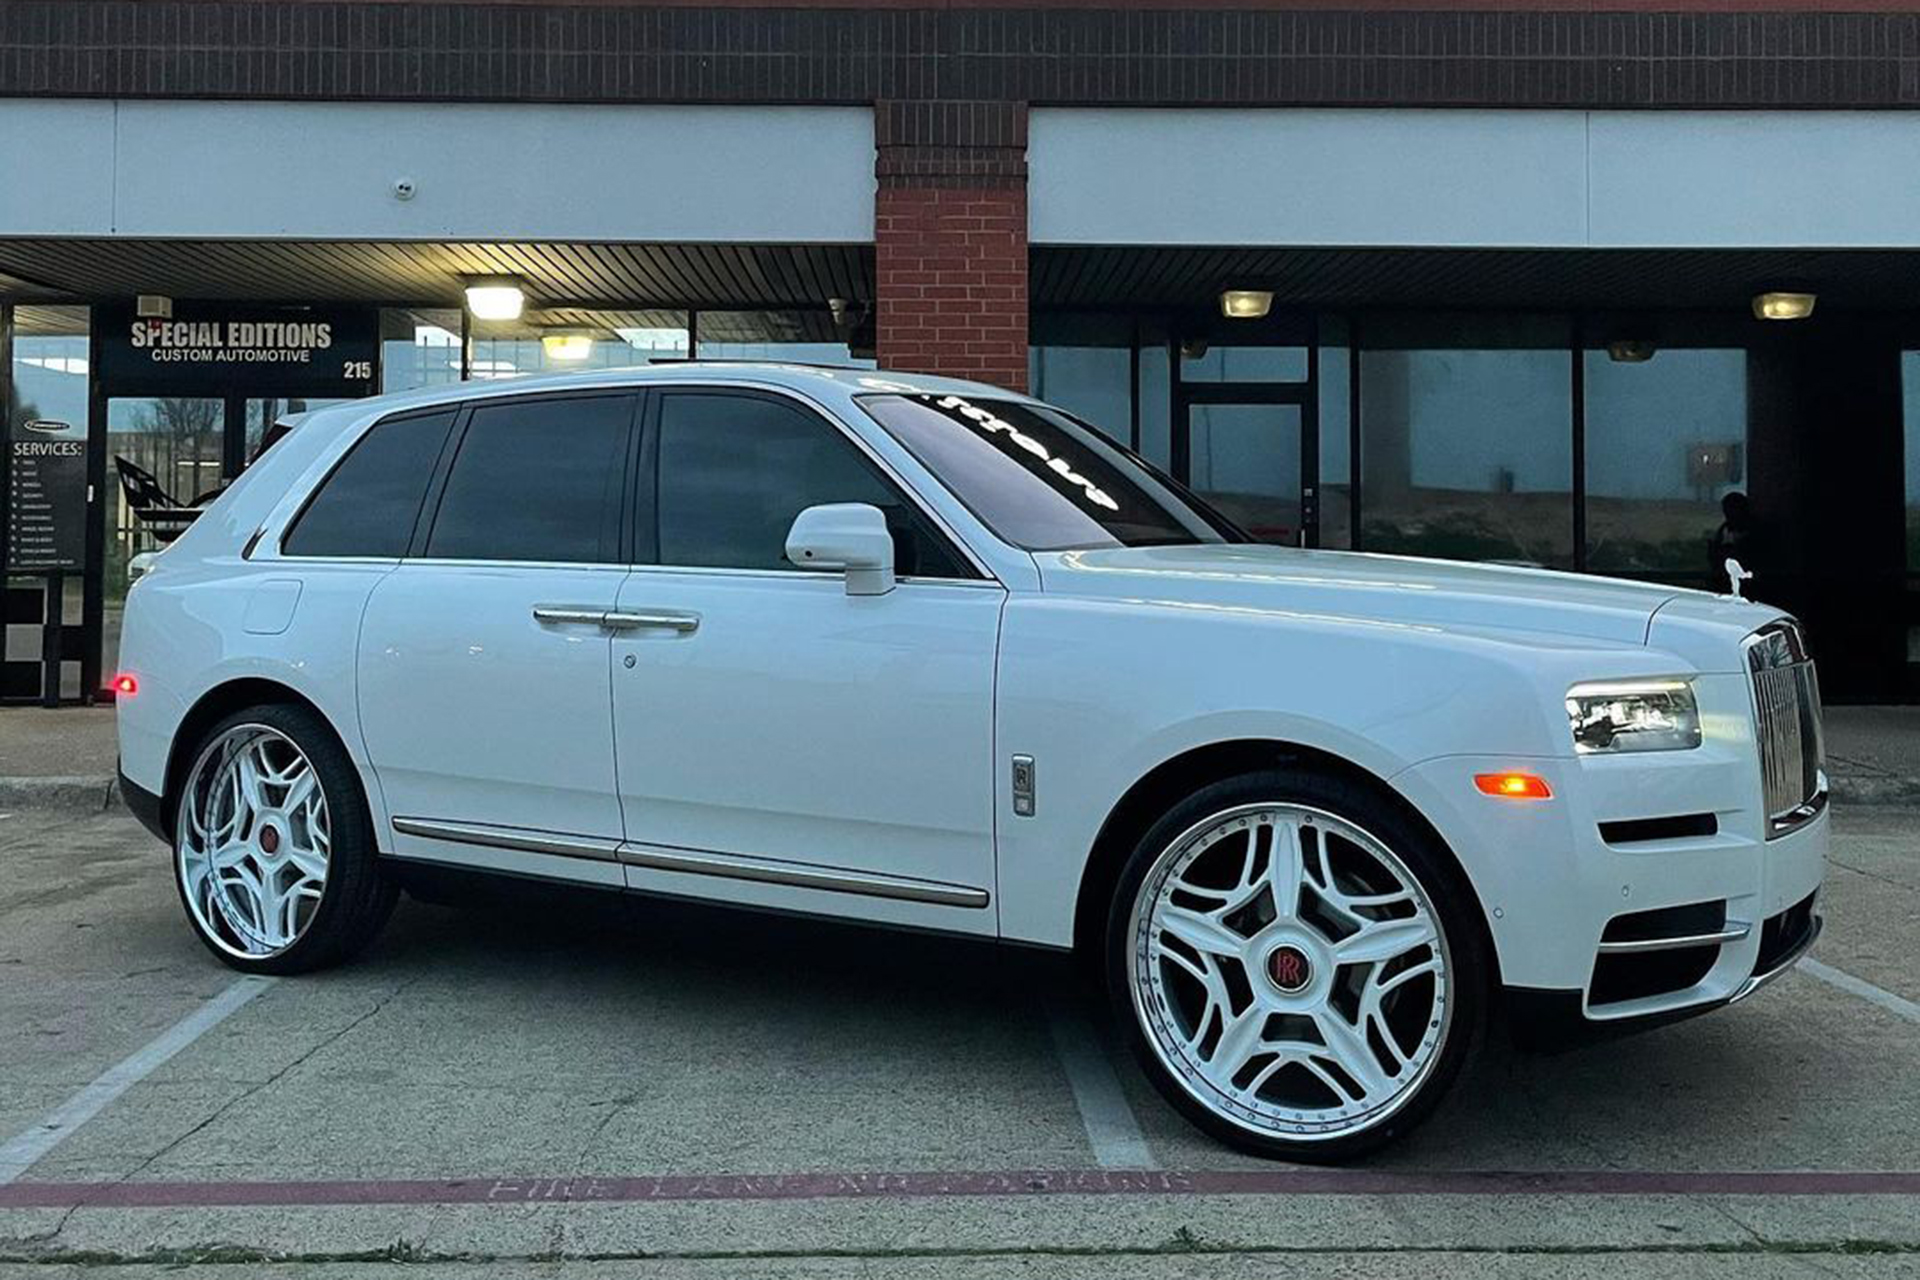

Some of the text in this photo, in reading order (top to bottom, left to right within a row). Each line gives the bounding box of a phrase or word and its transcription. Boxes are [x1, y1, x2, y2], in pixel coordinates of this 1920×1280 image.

[131, 321, 332, 348] SPECIAL EDITIONS
[152, 349, 310, 362] CUSTOM AUTOMOTIVE
[343, 361, 372, 379] 215
[13, 442, 82, 456] SERVICES:
